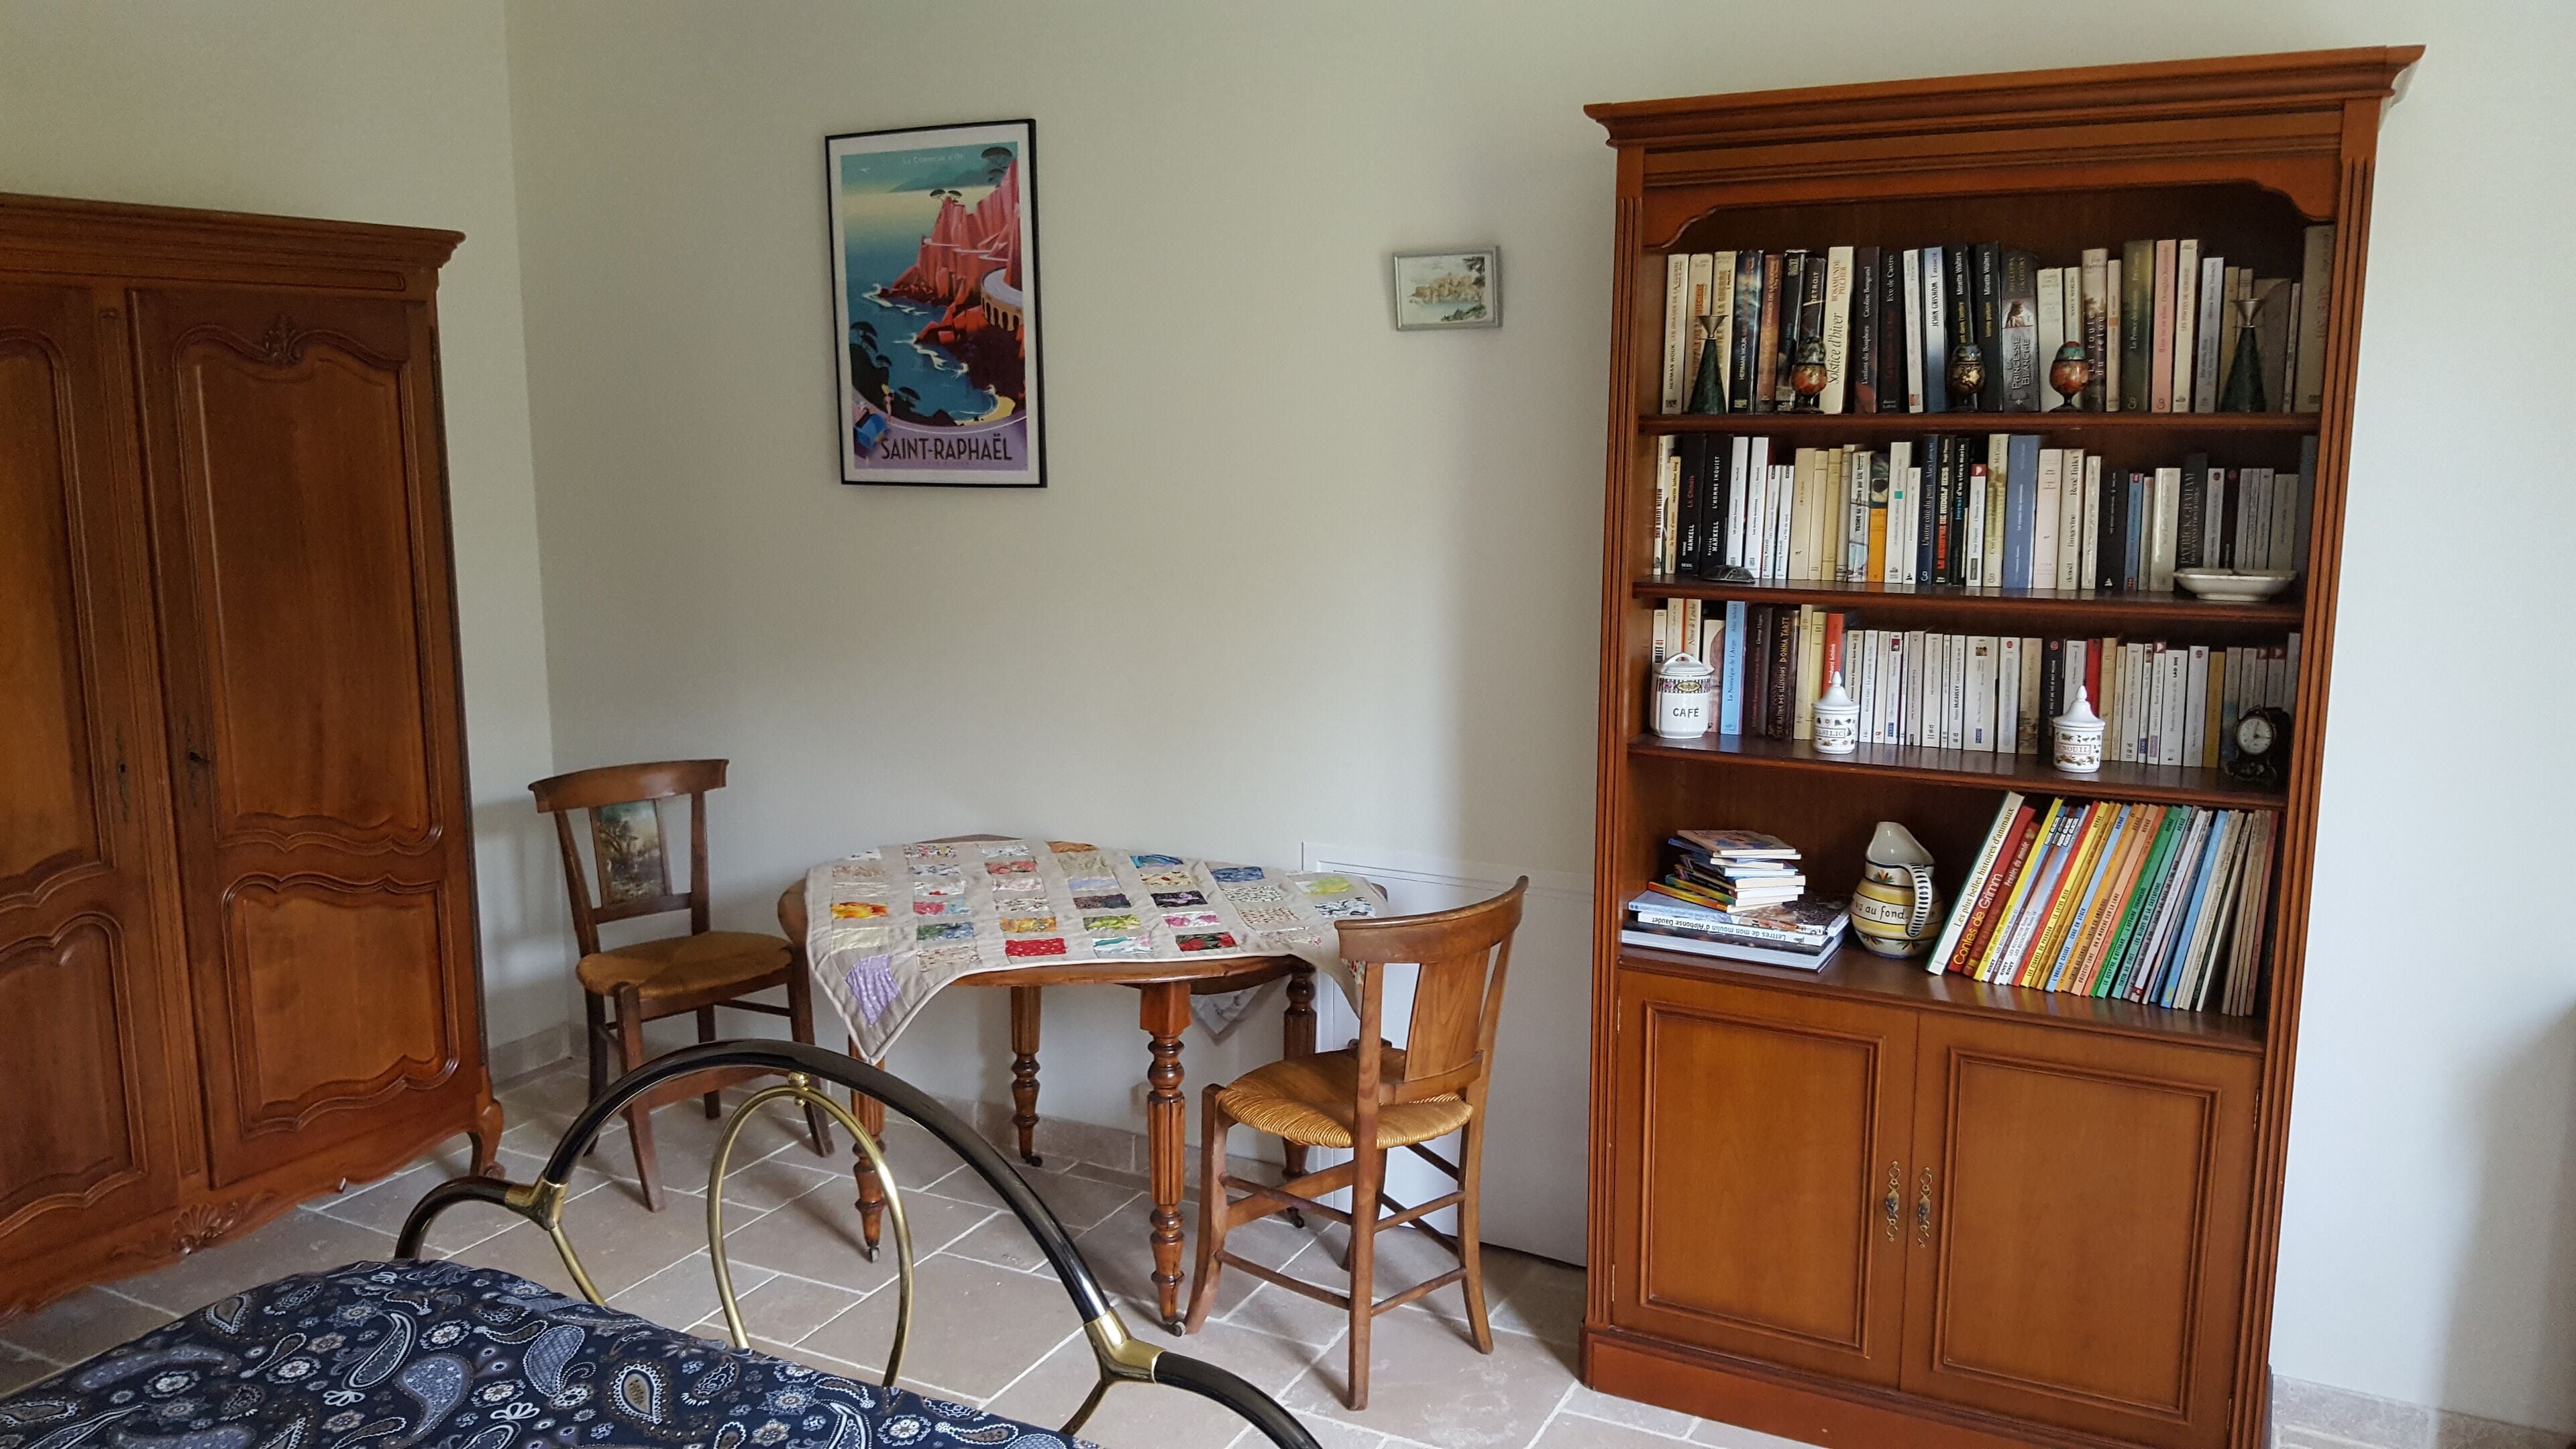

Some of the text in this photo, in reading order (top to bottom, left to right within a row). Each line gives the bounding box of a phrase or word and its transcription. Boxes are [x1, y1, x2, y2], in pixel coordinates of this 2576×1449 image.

[1886, 254, 1894, 277] Castro
[1954, 252, 1964, 295] Minette Walters
[1982, 252, 1991, 295] Minette Walters
[1931, 281, 1940, 327] JOHN GRISHAM
[1827, 313, 1843, 385] Solstice d'hiver
[2096, 309, 2104, 376] du retour
[2012, 337, 2023, 389] PRINCESSE
[2021, 339, 2031, 385] BLANCHE
[881, 433, 1012, 461] SAINT-RAPHAËL
[2070, 455, 2079, 475] Fallet
[1925, 484, 1933, 500] pont
[2070, 478, 2078, 496] René
[1711, 455, 1721, 551] MANKELL L'HOMME INQUIET
[1924, 500, 1931, 508] du
[1923, 510, 1931, 523] côté
[1937, 466, 1949, 569] LE MEURTRE DE RUDOLF HESS
[2180, 472, 2196, 564] PATRICK GRAHAM
[1687, 524, 1695, 551] MANKELL
[1921, 523, 1930, 546] L'autre
[1780, 617, 1789, 637] TARTT
[1780, 639, 1788, 662] DONNA
[1672, 706, 1700, 718] CAFÉ
[2015, 840, 2029, 860] monde
[1953, 806, 2017, 928] Les plus belles histoires d'animaux
[2060, 888, 2070, 900] BLEU
[2148, 881, 2162, 907] CASTAFIORE
[2165, 881, 2171, 890] DE
[2054, 899, 2064, 913] LOTUS
[2108, 902, 2116, 910] LA
[2111, 892, 2121, 904] LUNE
[2133, 885, 2147, 910] TOURNESOL
[1865, 905, 1877, 915] au
[1880, 903, 1905, 921] fond
[1951, 870, 2004, 967] Contes de Grimm
[2076, 906, 2087, 920] STOCK
[2104, 908, 2113, 920] SUR
[2143, 913, 2150, 921] DE
[2145, 906, 2153, 914] LA
[1651, 917, 1675, 927] Daudet
[1676, 920, 1712, 933] d'Alphonse
[2073, 920, 2081, 929] EN
[2090, 918, 2098, 926] EN
[2096, 918, 2109, 937] MARCHÉ
[2124, 910, 2137, 931] L'AFFAIRE
[2137, 920, 2147, 937] BIJOUX
[1712, 926, 1735, 934] moulin
[1767, 932, 1786, 942] Lettres
[2040, 924, 2053, 945] PHARAON
[2068, 928, 2078, 940] COKE
[2092, 940, 2100, 949] ON
[2112, 936, 2126, 961] D'OTTOKAR
[2133, 936, 2141, 947] LES
[1986, 957, 1996, 973] BINET
[2030, 950, 2042, 969] CIGARES
[2085, 951, 2095, 965] LUNE
[2126, 951, 2136, 965] TIBET
[1998, 961, 2010, 976] BINET
[2004, 960, 2015, 975] BINET
[2026, 967, 2035, 977] LES
[2050, 960, 2063, 981] L'OREILLE
[2077, 963, 2090, 983] OBJECTIF
[2104, 961, 2116, 980] SCEPTRE
[2123, 964, 2131, 973] AU
[2101, 978, 2109, 987] LE
[2117, 971, 2128, 987] TINTIN
